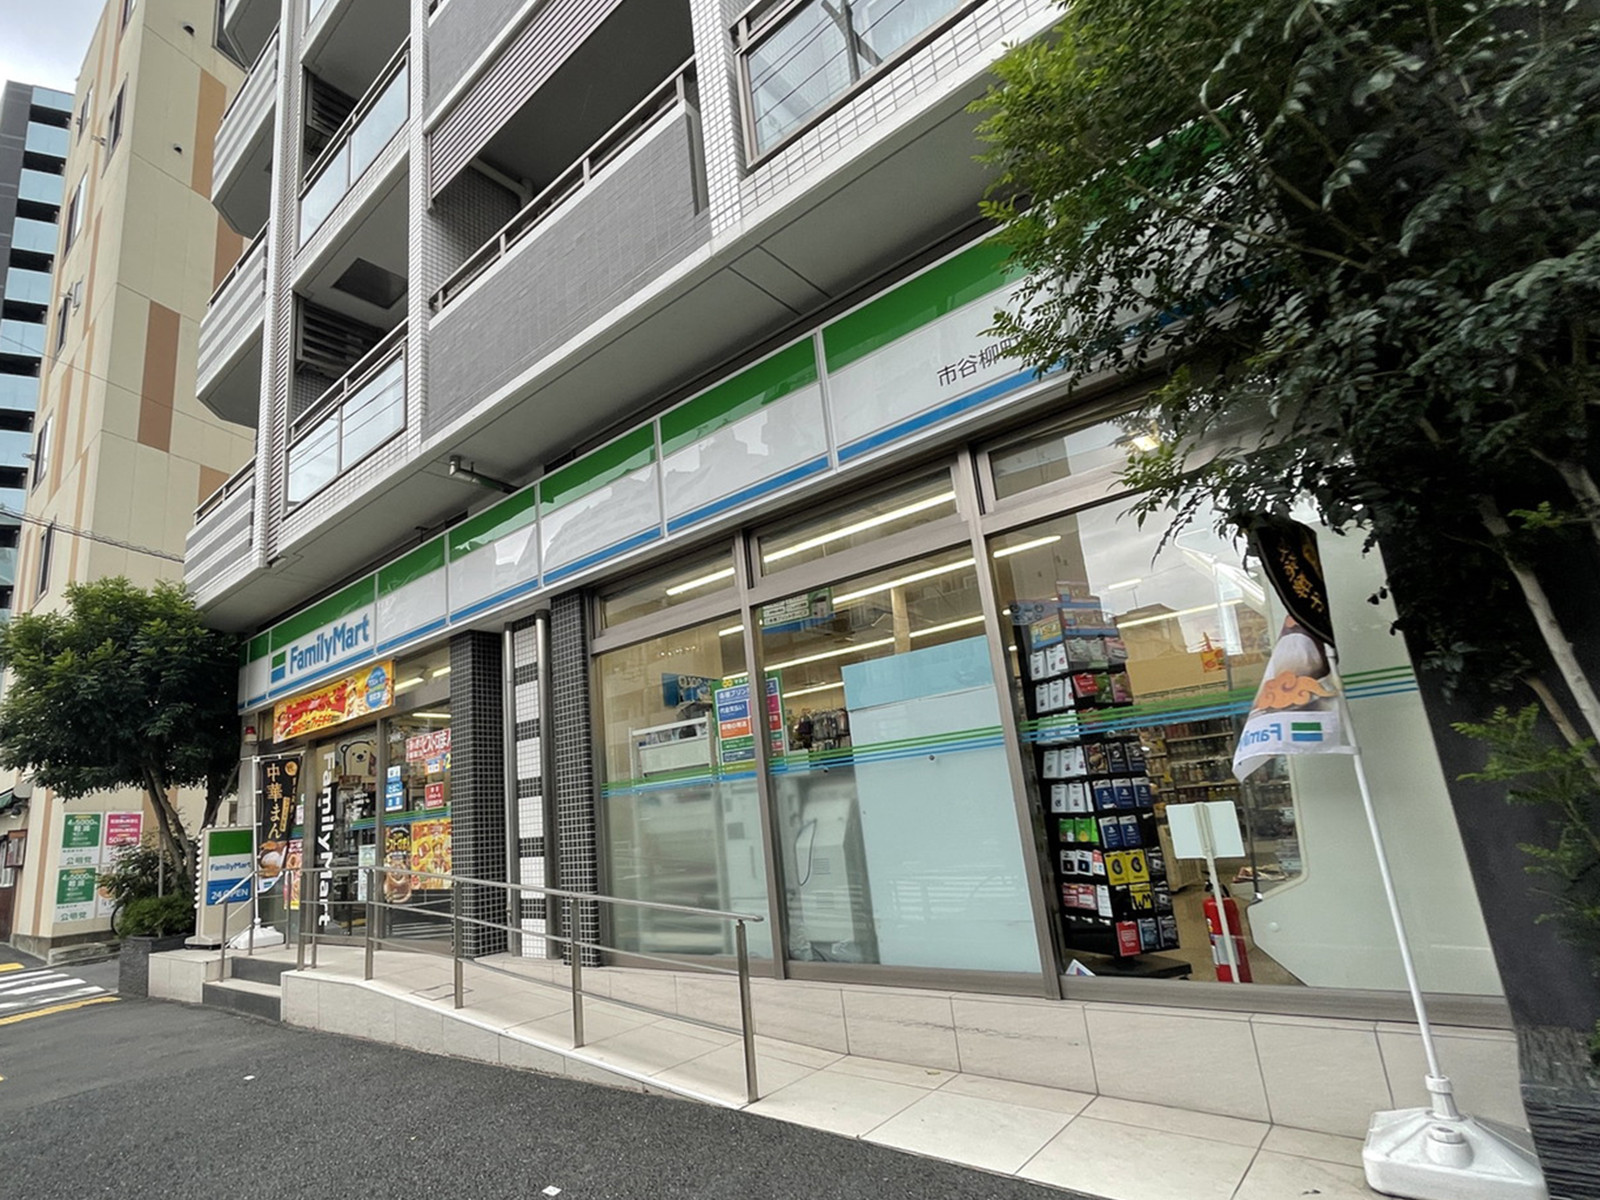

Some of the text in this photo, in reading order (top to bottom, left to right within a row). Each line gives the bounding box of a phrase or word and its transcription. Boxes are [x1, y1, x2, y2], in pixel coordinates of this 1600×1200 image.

[289, 613, 370, 675] FamilyMart
[266, 763, 283, 840] 中華まん
[210, 861, 252, 872] FamilyMart
[318, 752, 335, 927] FamilyMart
